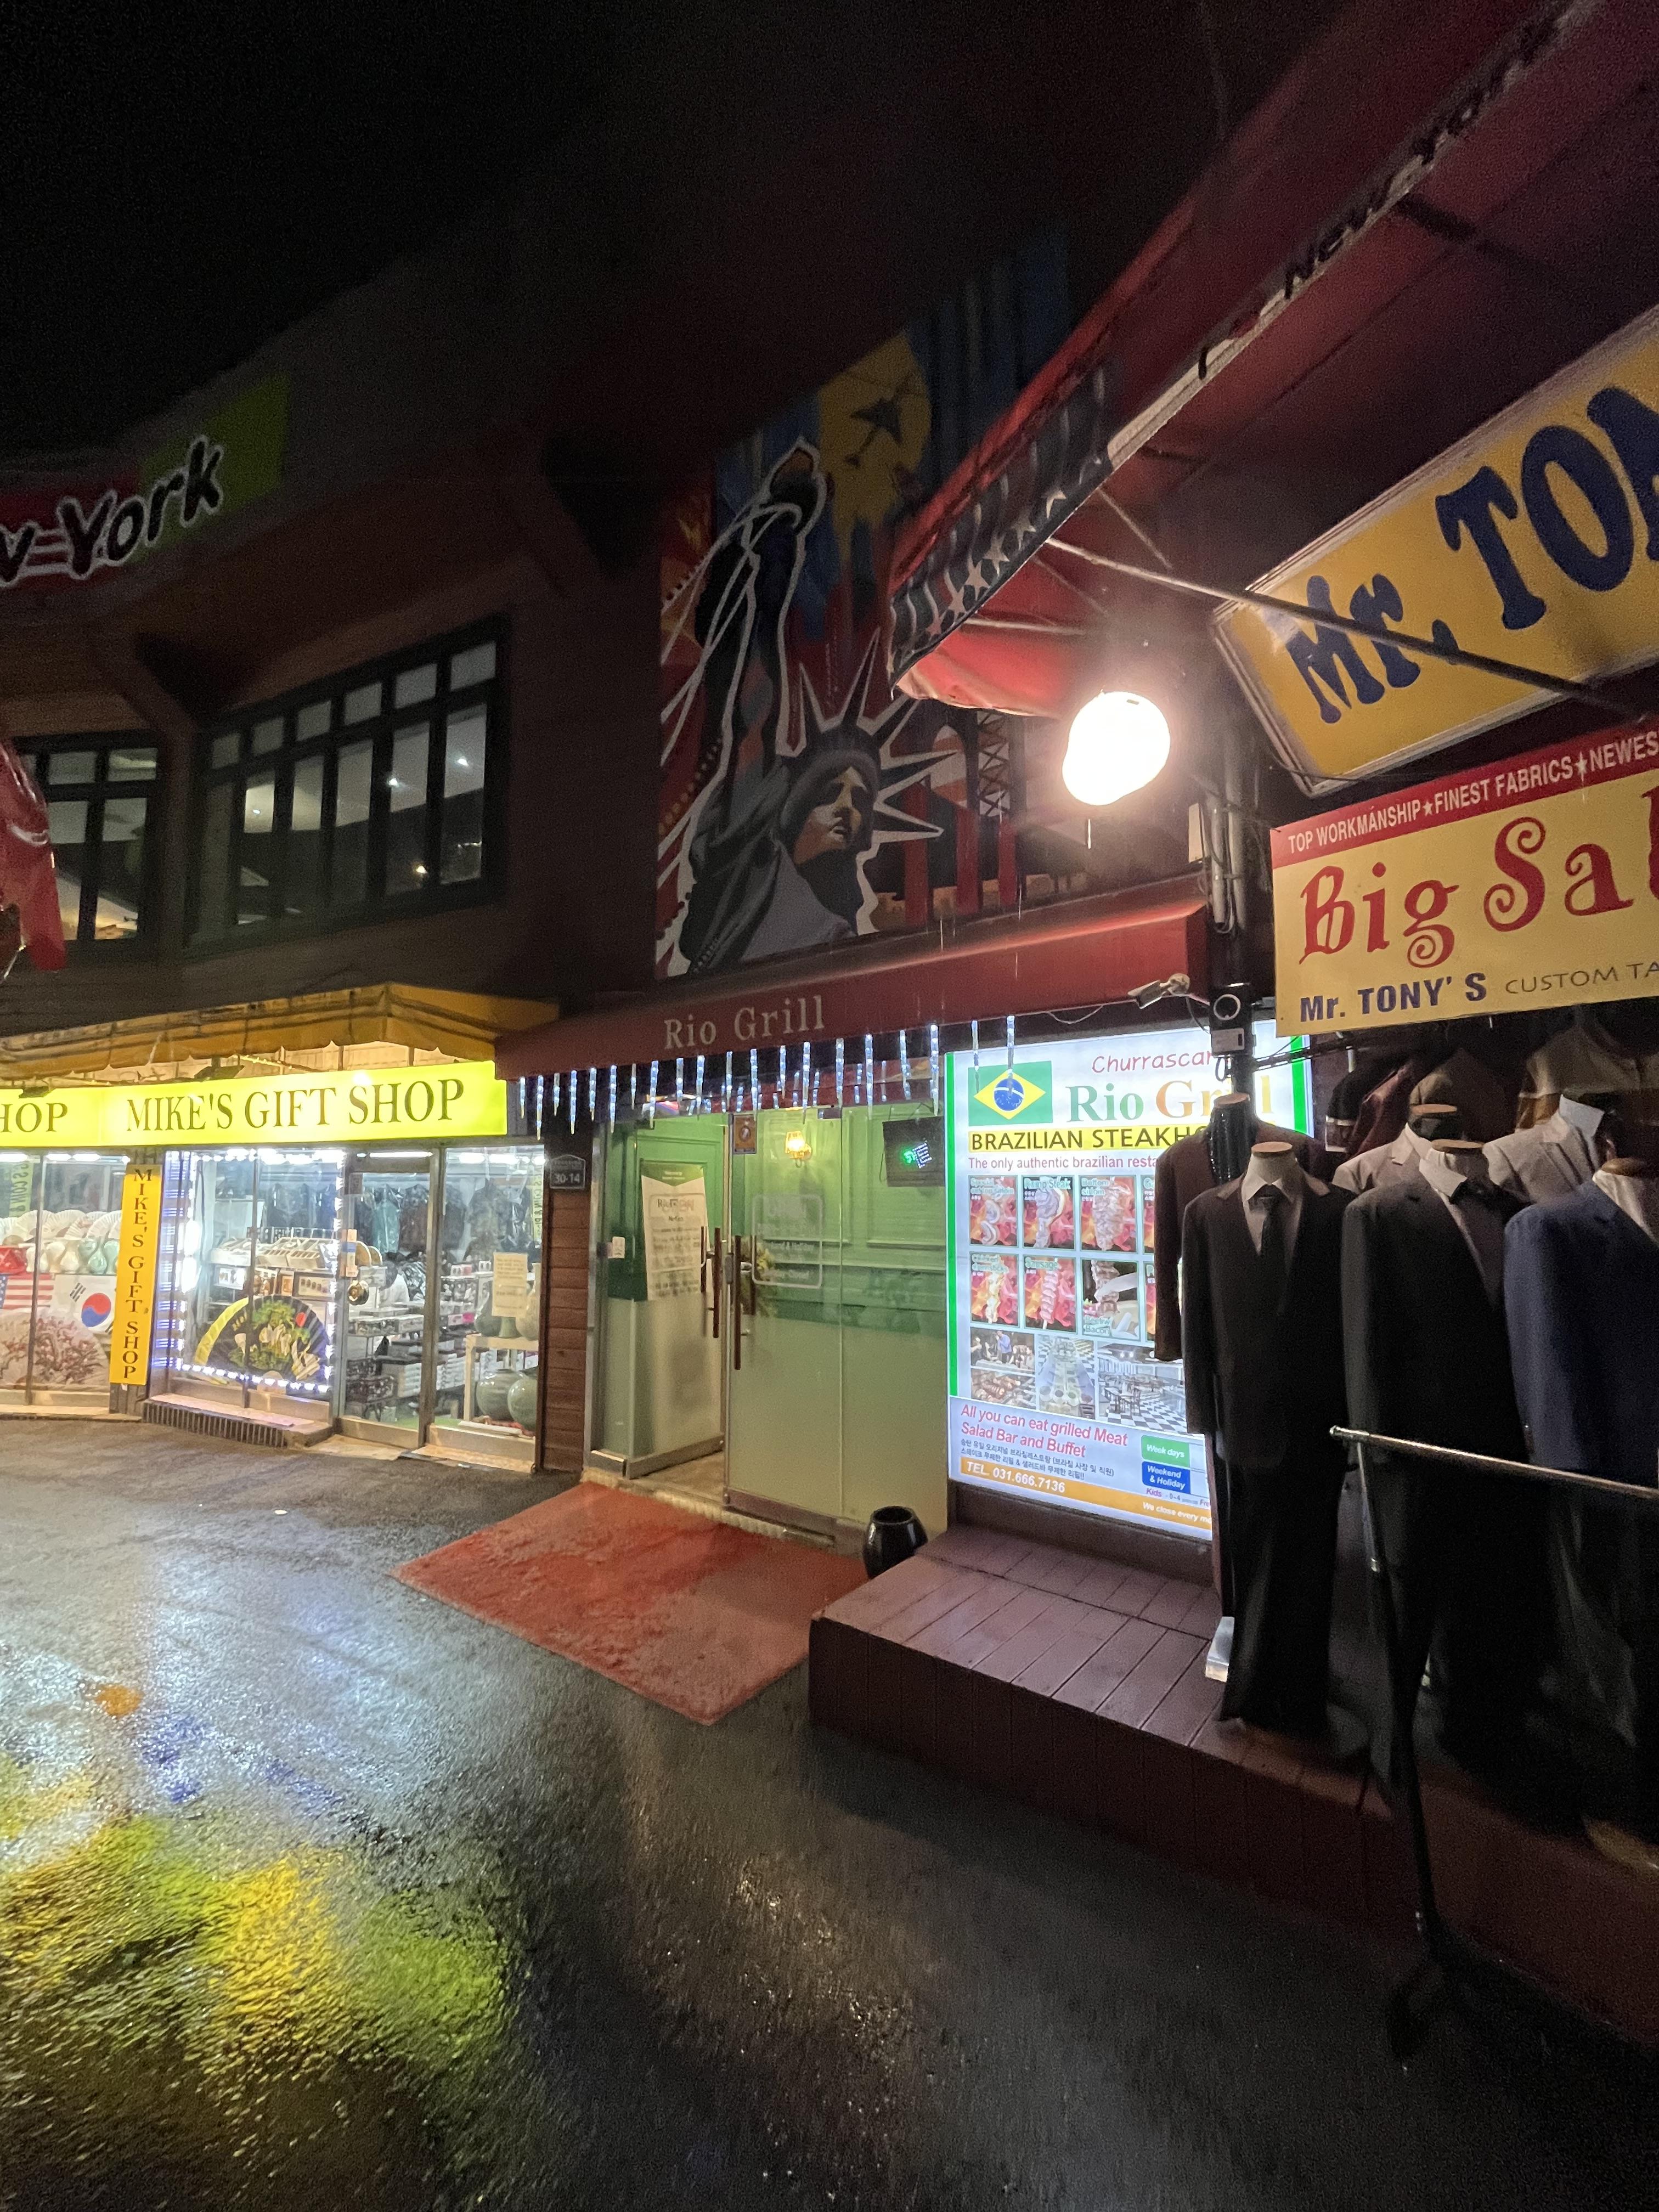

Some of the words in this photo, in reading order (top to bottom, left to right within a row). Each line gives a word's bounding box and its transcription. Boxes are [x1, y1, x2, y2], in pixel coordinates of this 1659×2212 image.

[1288, 832, 1313, 854] TOP
[1316, 799, 1421, 846] WORKMANSHIP
[1434, 781, 1489, 814] FINEST
[1496, 755, 1573, 798] FABRICS
[1299, 861, 1459, 969] Big
[1300, 995, 1346, 1023] Mr.
[1505, 967, 1618, 995] CUSTOM
[664, 1014, 716, 1049] Rio
[734, 995, 825, 1041] Grill
[127, 1093, 233, 1132] MIKE'S
[245, 1087, 337, 1128] GIFT
[349, 1078, 464, 1125] SHOP
[1066, 1082, 1144, 1122] Rio
[1156, 1075, 1273, 1119] Grl
[972, 1130, 1083, 1150] BRAZILIAN
[1092, 1125, 1207, 1148] STEAKH
[968, 1157, 988, 1170] The
[991, 1155, 1013, 1171] only
[1017, 1155, 1069, 1169] authentic
[1073, 1154, 1124, 1169] brazilian
[1127, 1155, 1156, 1168] resta
[133, 1169, 153, 1248] MIKE'S
[125, 1255, 144, 1313] GIFT
[122, 1320, 139, 1379] SHOP
[961, 1404, 977, 1418] All
[979, 1409, 1000, 1423] you
[1004, 1414, 1025, 1427] can
[1029, 1417, 1048, 1431] eat
[1051, 1421, 1091, 1439] grilled
[1094, 1427, 1128, 1446] Meat
[961, 1421, 994, 1440] Salad
[996, 1428, 1018, 1444] Bar
[1020, 1436, 1044, 1449] and
[1047, 1438, 1086, 1458] Buffet
[1147, 1444, 1166, 1454] Week
[1167, 1449, 1185, 1458] days
[1148, 1465, 1182, 1479] Weekend
[992, 1467, 1065, 1493] 031.666.7136
[1146, 1488, 1162, 1497] Kids
[1157, 1477, 1186, 1490] Holiday
[1143, 1502, 1154, 1511] We
[1156, 1506, 1176, 1515] close
[1177, 1510, 1199, 1522] every
